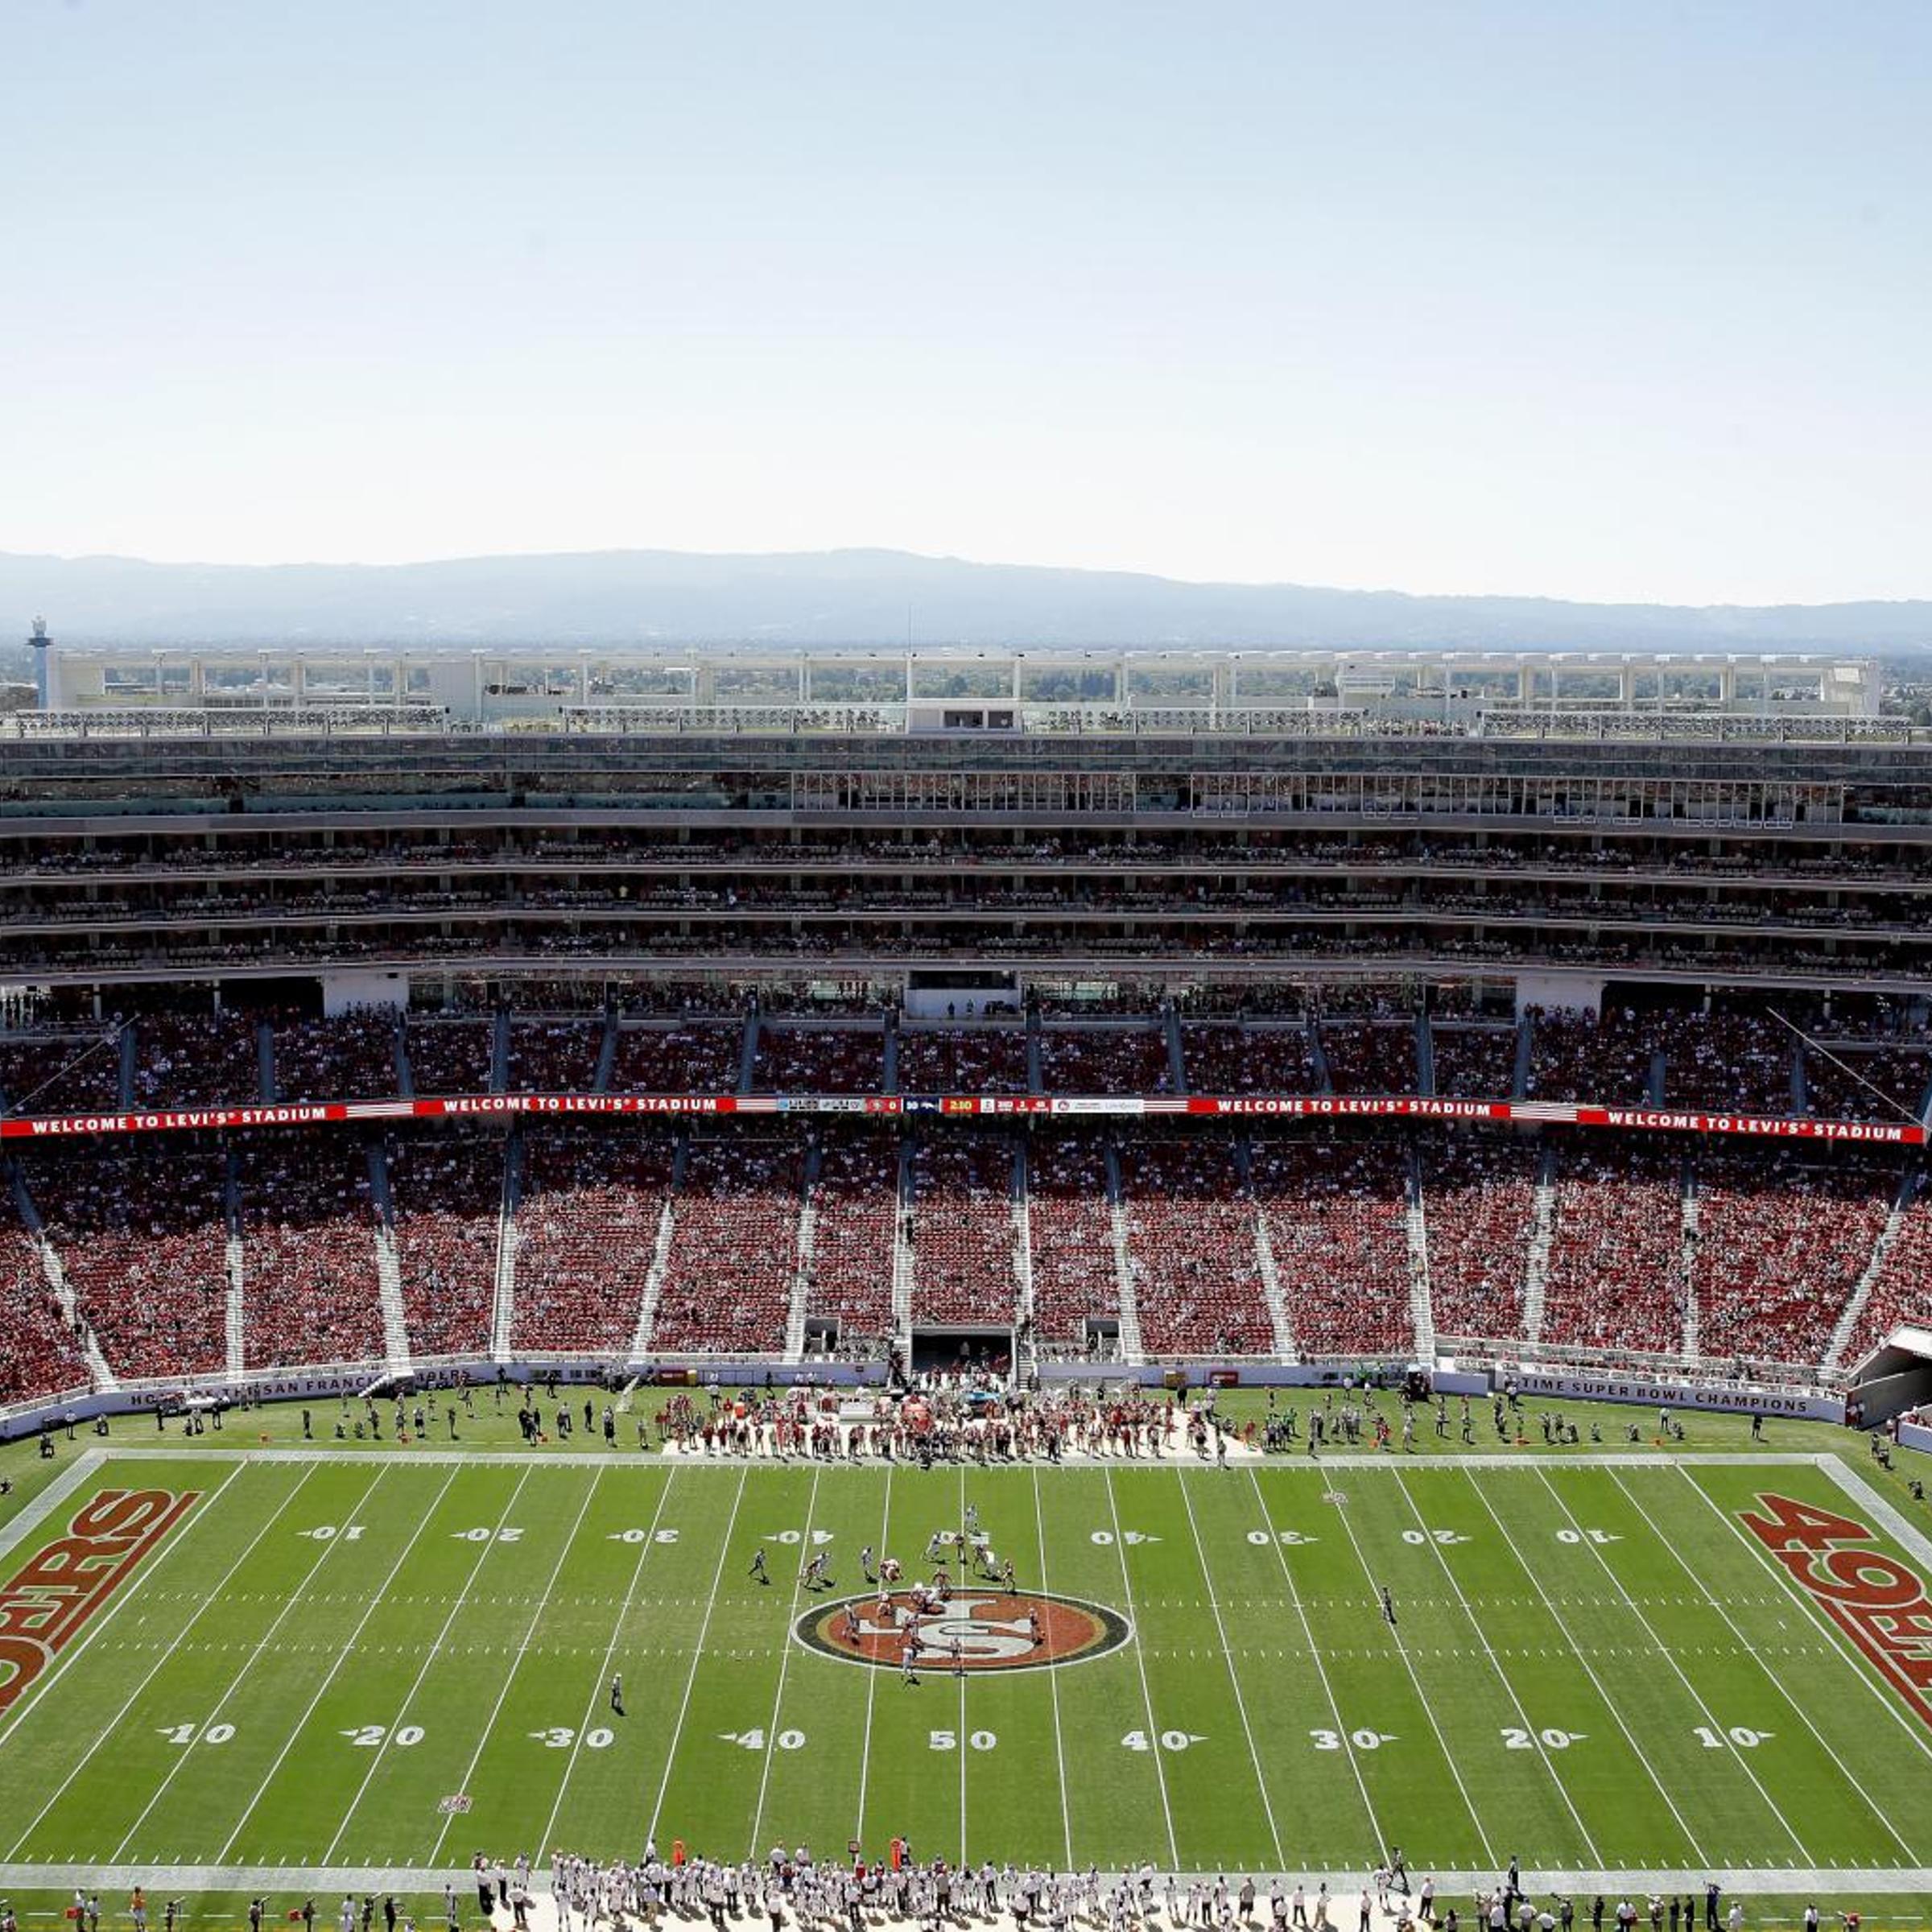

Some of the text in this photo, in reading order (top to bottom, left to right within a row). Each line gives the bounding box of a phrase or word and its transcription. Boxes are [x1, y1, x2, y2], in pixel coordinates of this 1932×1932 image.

[444, 1098, 531, 1112] WELCOME
[538, 1098, 559, 1110] TO
[637, 1098, 716, 1111] STADIUM
[1218, 1100, 1303, 1112] WELCOME
[1311, 1100, 1332, 1112] TO
[1410, 1101, 1489, 1116] STADIUM
[32, 1117, 127, 1134] WELCOME
[135, 1116, 159, 1127] TO
[242, 1108, 325, 1123] STADIUM
[1608, 1113, 1699, 1128] WELCOME
[1707, 1117, 1730, 1129] TO
[1814, 1124, 1902, 1140] STADIUM
[263, 1381, 298, 1395] SAN
[307, 1375, 382, 1392] FRANCI
[1521, 1377, 1807, 1412] TIME SUPER BOWL CHAMPIONS
